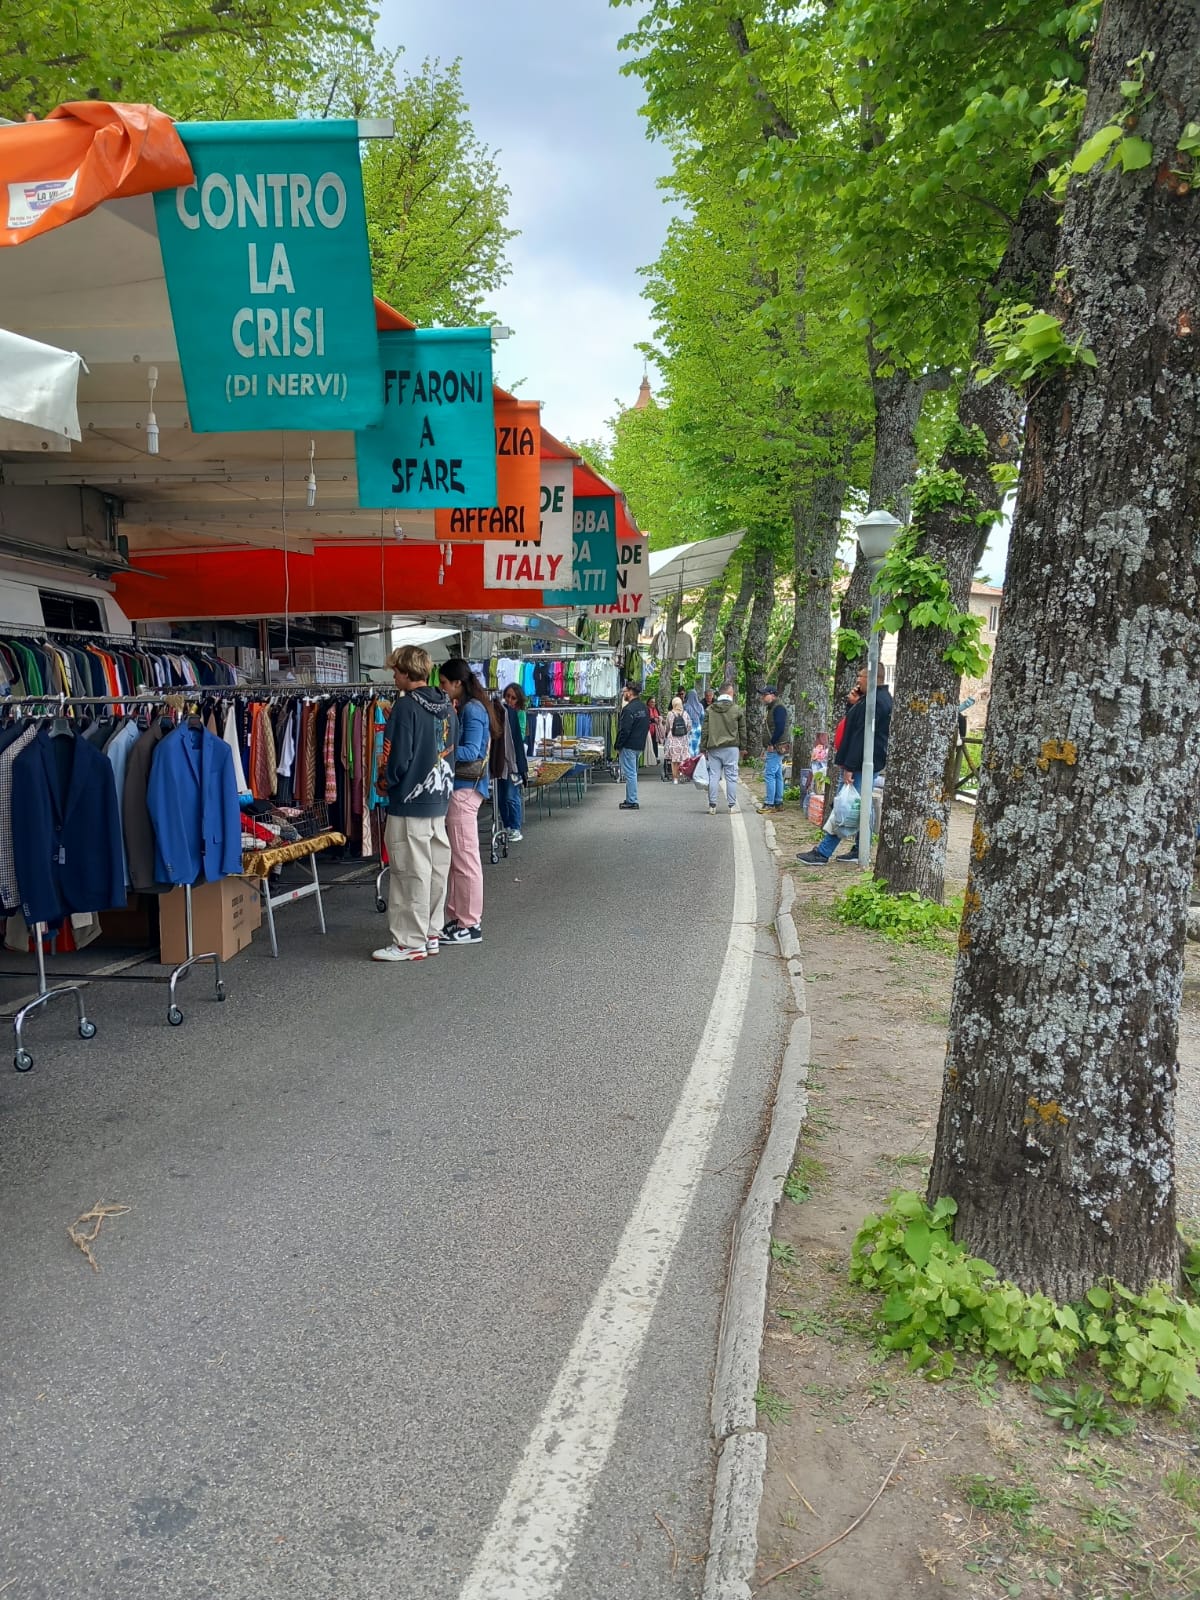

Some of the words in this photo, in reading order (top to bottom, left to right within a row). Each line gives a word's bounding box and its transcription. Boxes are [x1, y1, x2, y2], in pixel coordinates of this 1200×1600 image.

[176, 172, 347, 230] CONTRO
[248, 242, 296, 294] LA
[232, 307, 325, 359] CRISI
[226, 374, 258, 403] (DI
[267, 373, 348, 402] NERVI)
[384, 369, 483, 406] FFARONI
[420, 414, 435, 449] A
[495, 427, 534, 456] ZIA
[391, 457, 466, 494] SFARE
[540, 485, 566, 513] DE
[450, 505, 525, 534] AFFARI
[573, 510, 610, 533] BBA
[495, 554, 564, 581] ITALY
[616, 544, 643, 565] DE
[553, 568, 607, 592] ATTI
[616, 569, 628, 589] N
